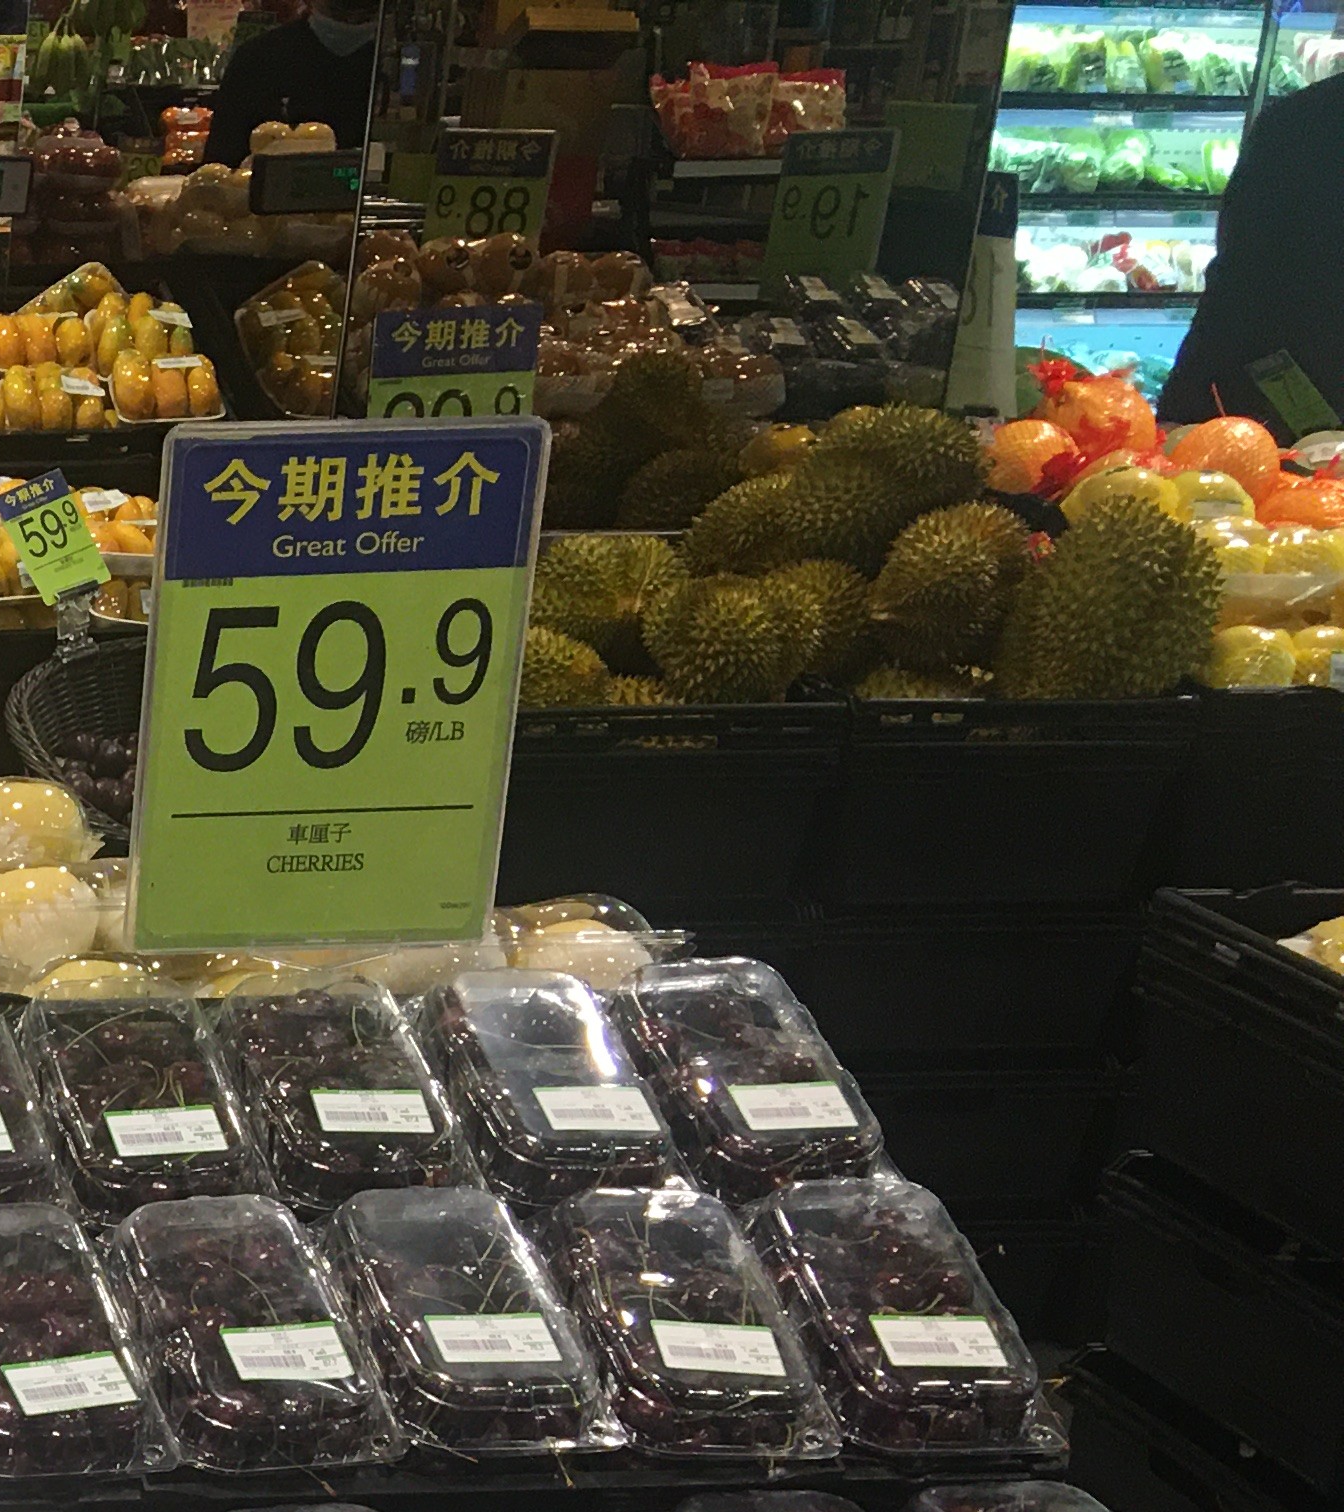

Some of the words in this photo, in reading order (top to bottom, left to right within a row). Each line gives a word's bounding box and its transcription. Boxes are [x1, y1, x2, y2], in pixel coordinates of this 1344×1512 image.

[391, 317, 525, 353] 今期推介
[2, 474, 65, 509] 今期推介
[204, 451, 501, 525] 今期推介
[16, 500, 81, 560] 59.9
[272, 534, 346, 559] Great
[355, 531, 424, 555] Offer
[183, 597, 494, 773] 59.9
[405, 720, 465, 745] 磅/LB
[287, 823, 352, 846] 車厘子
[266, 853, 364, 873] CHERRIES
